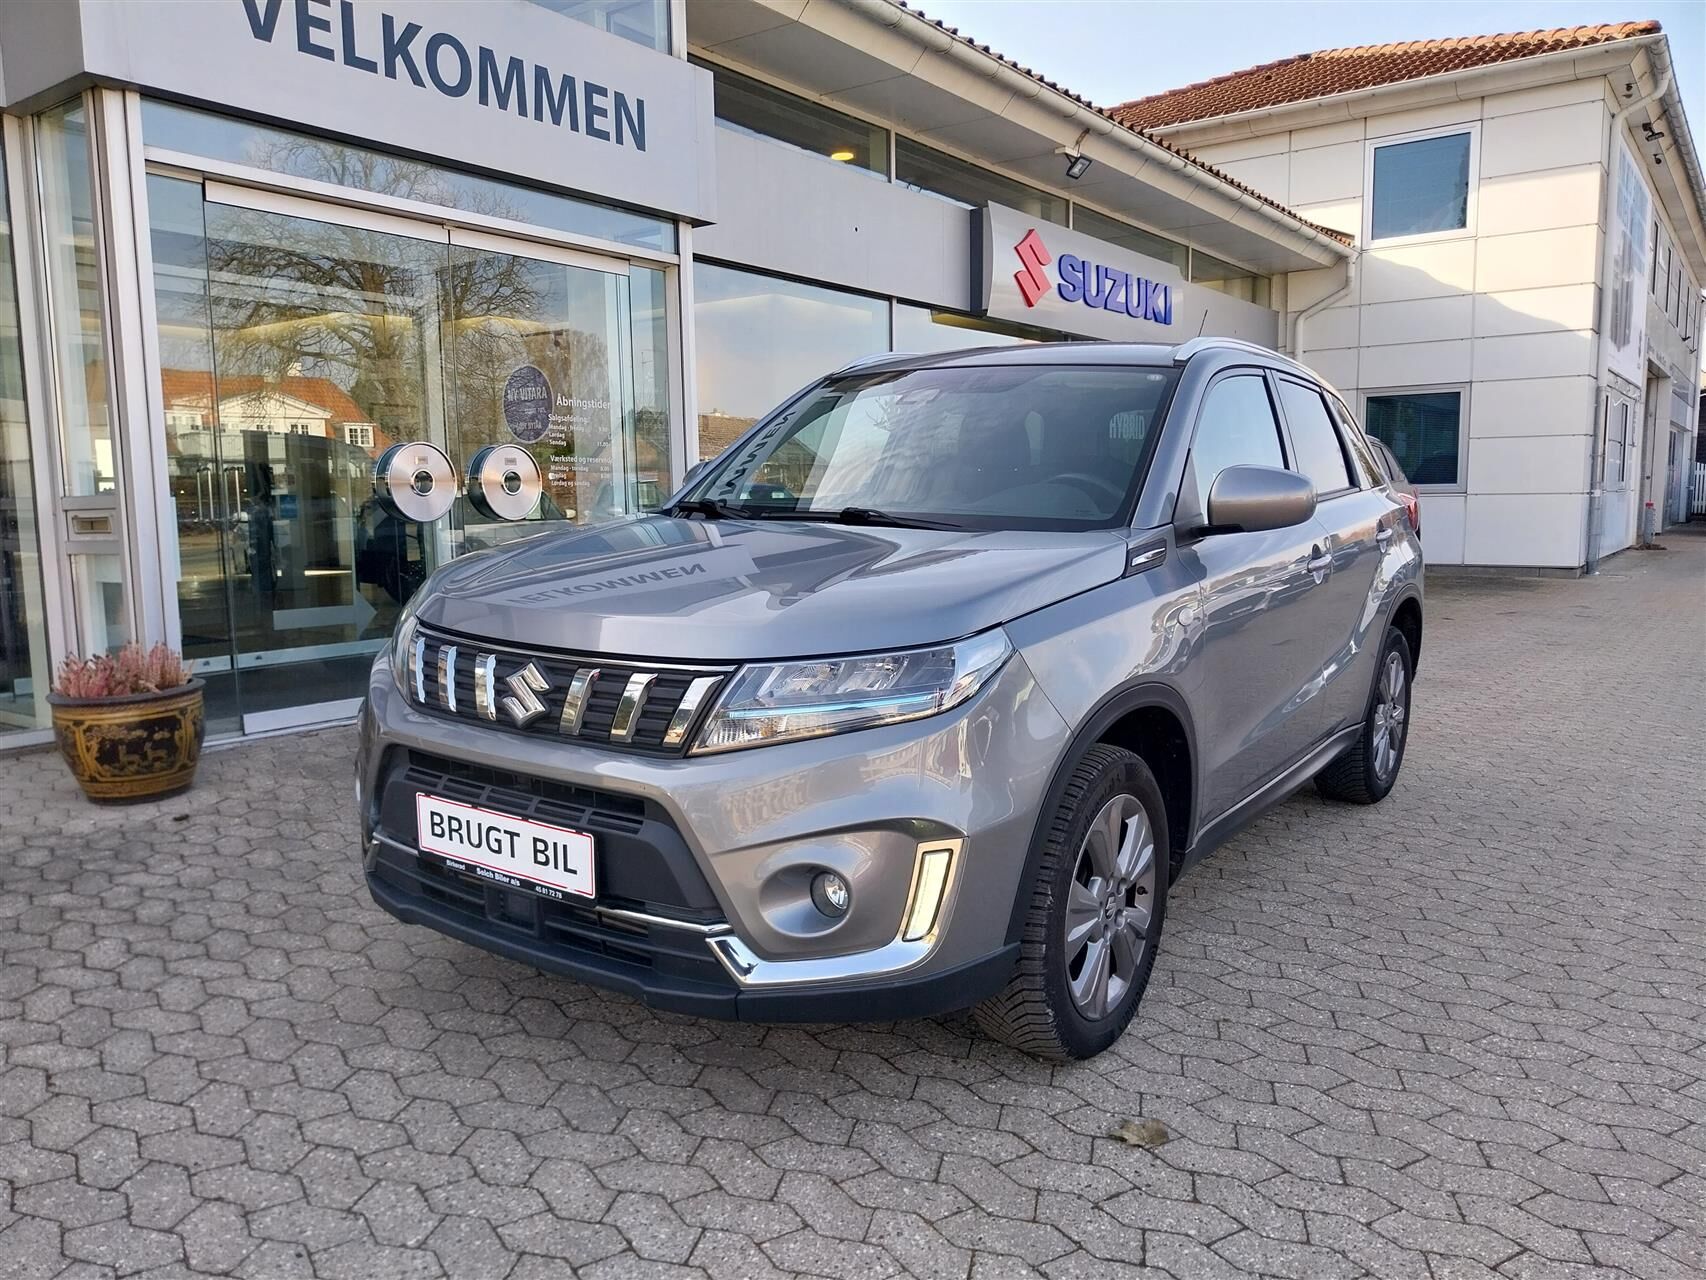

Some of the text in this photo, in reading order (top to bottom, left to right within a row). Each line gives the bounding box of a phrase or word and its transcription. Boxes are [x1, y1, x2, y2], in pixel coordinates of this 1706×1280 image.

[242, 0, 646, 152] VELKOMMEN
[1058, 254, 1173, 325] SUZUKI
[520, 386, 547, 400] VITARA
[556, 393, 611, 410] Åbningstider
[1109, 414, 1145, 440] HYBRID
[550, 454, 578, 463] Værksted
[430, 810, 578, 876] BRUGT BIL
[494, 872, 510, 883] Biler
